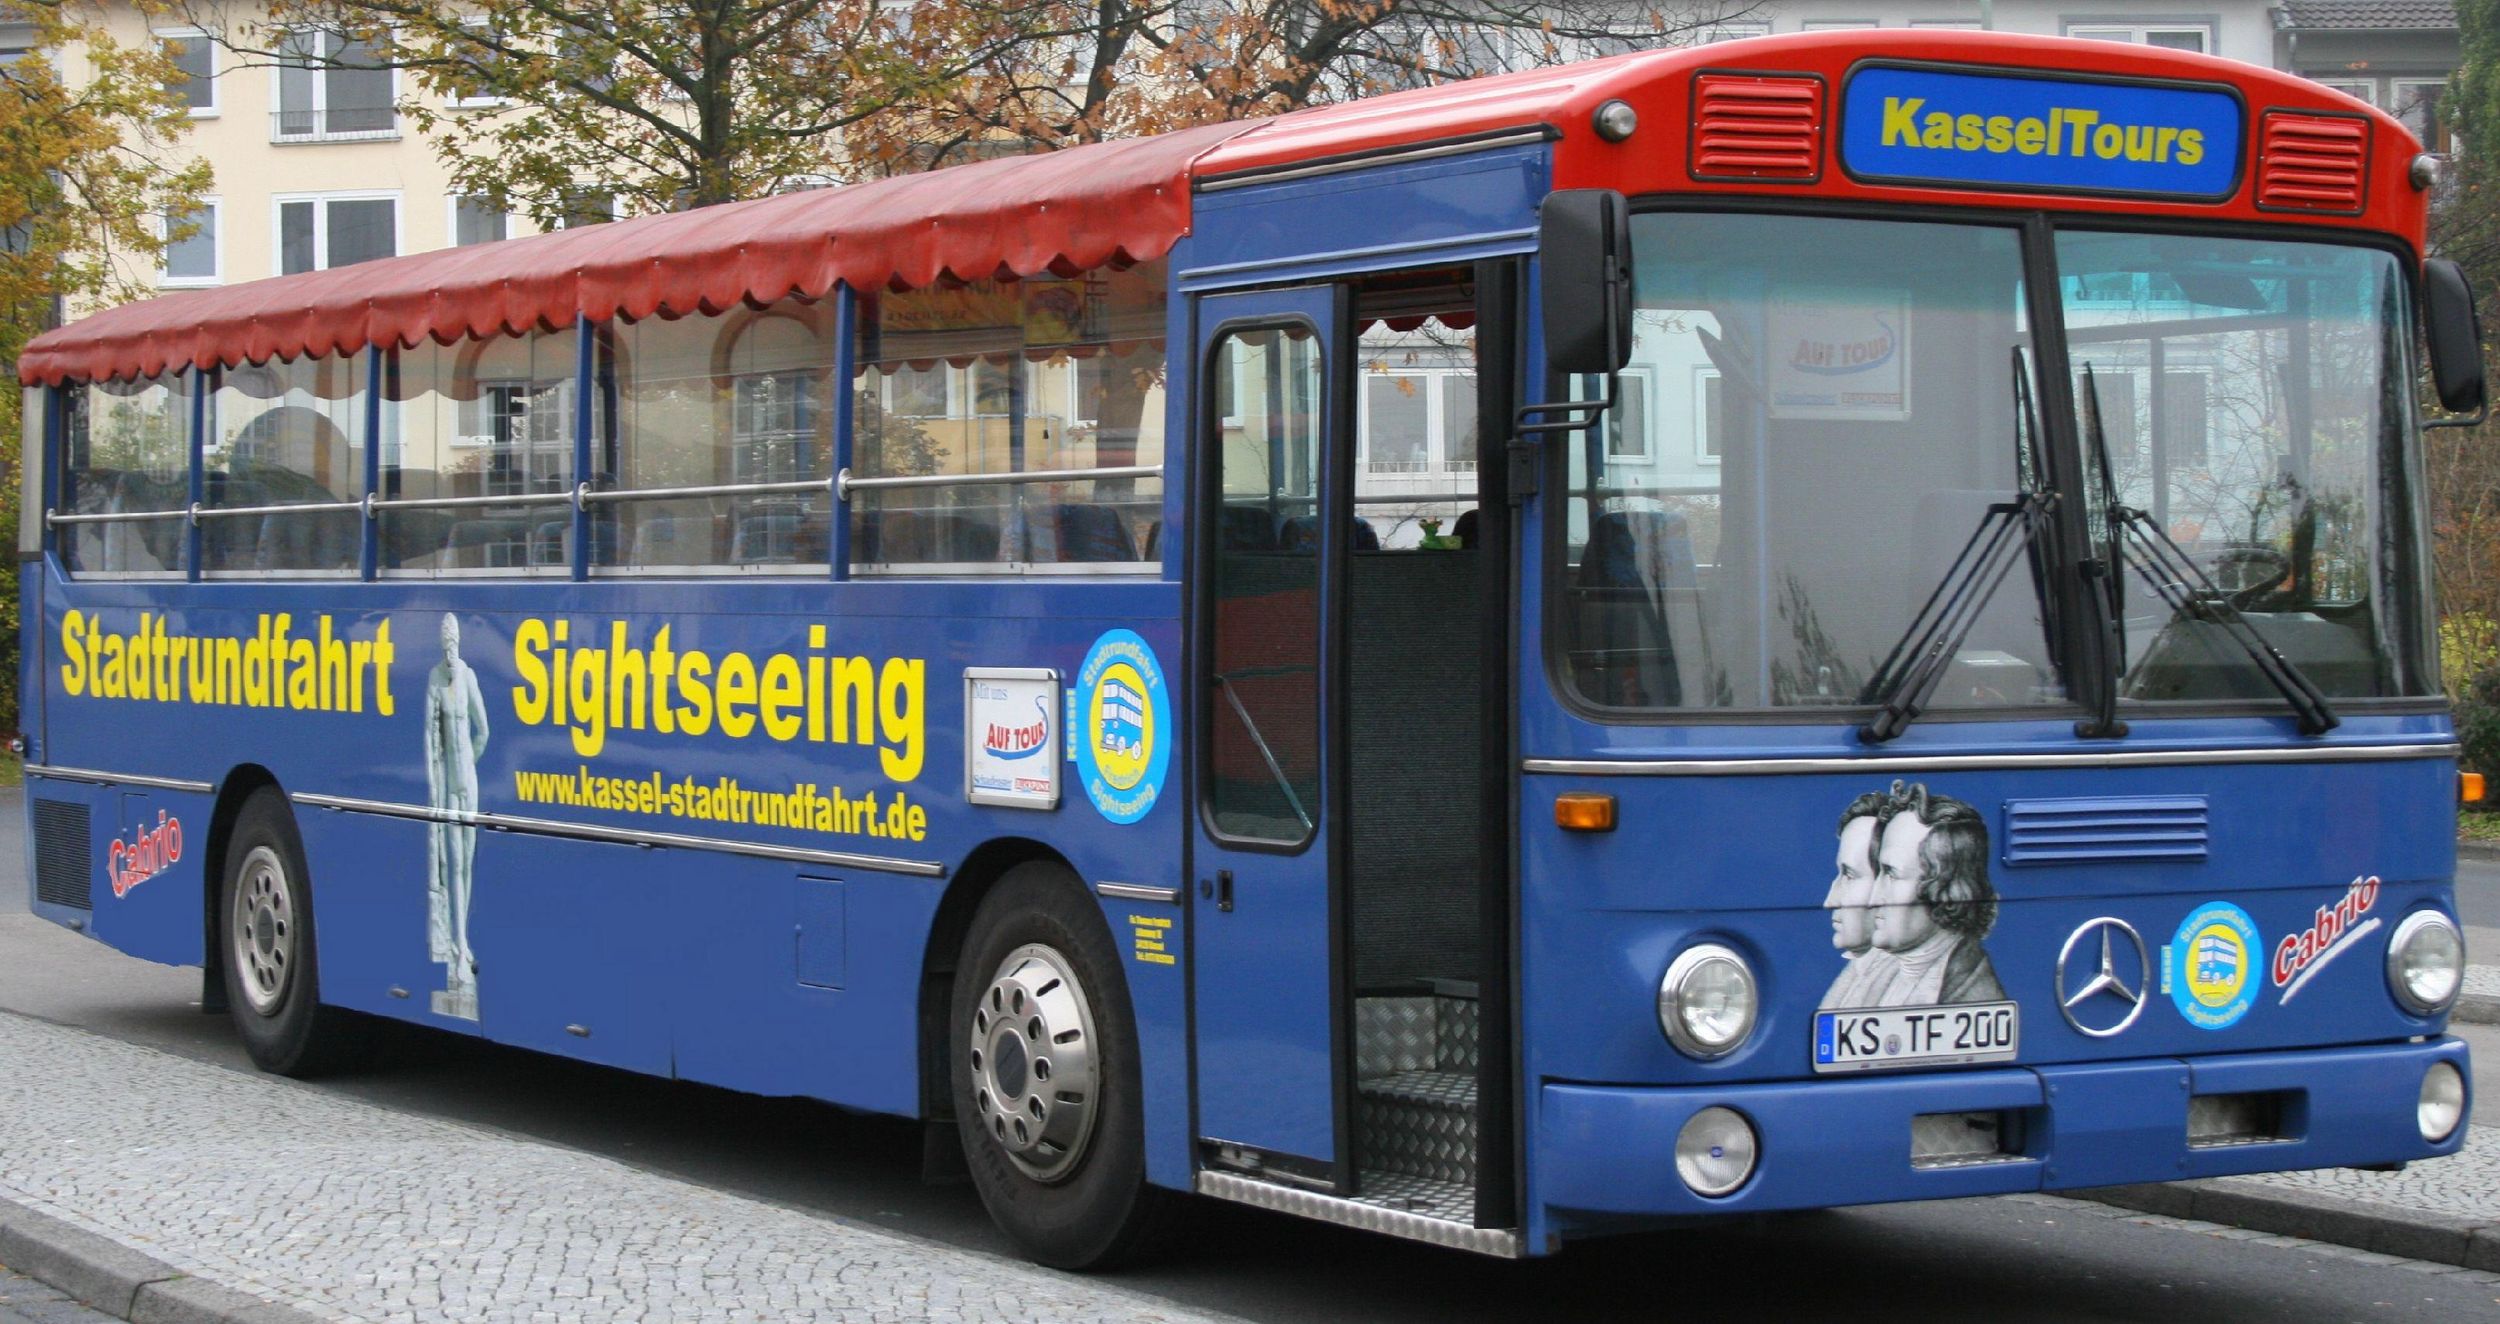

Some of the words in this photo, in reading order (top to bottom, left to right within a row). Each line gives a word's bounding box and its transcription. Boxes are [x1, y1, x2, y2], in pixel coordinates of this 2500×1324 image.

[1881, 97, 2205, 165] KasselTours
[1795, 339, 1834, 367] AUF
[1840, 336, 1888, 366] TOUR
[61, 609, 395, 716] Stadtrundfahrt
[1084, 641, 1158, 689] Stadtrundfahrt
[513, 618, 925, 782] Sightseeing
[1067, 689, 1077, 761] Kassel
[986, 722, 1010, 750] AUF
[1014, 721, 1045, 750] TOUR
[515, 765, 927, 842] www.kassel-stadtrundfahrt.de
[1091, 778, 1155, 816] Sightseeing
[109, 808, 182, 897] Cabrio
[2272, 875, 2382, 987] Cabrio
[1821, 1044, 1830, 1055] D
[1837, 1017, 1881, 1056] KS
[1905, 1013, 1946, 1052] TF
[1954, 1009, 2012, 1049] 200
